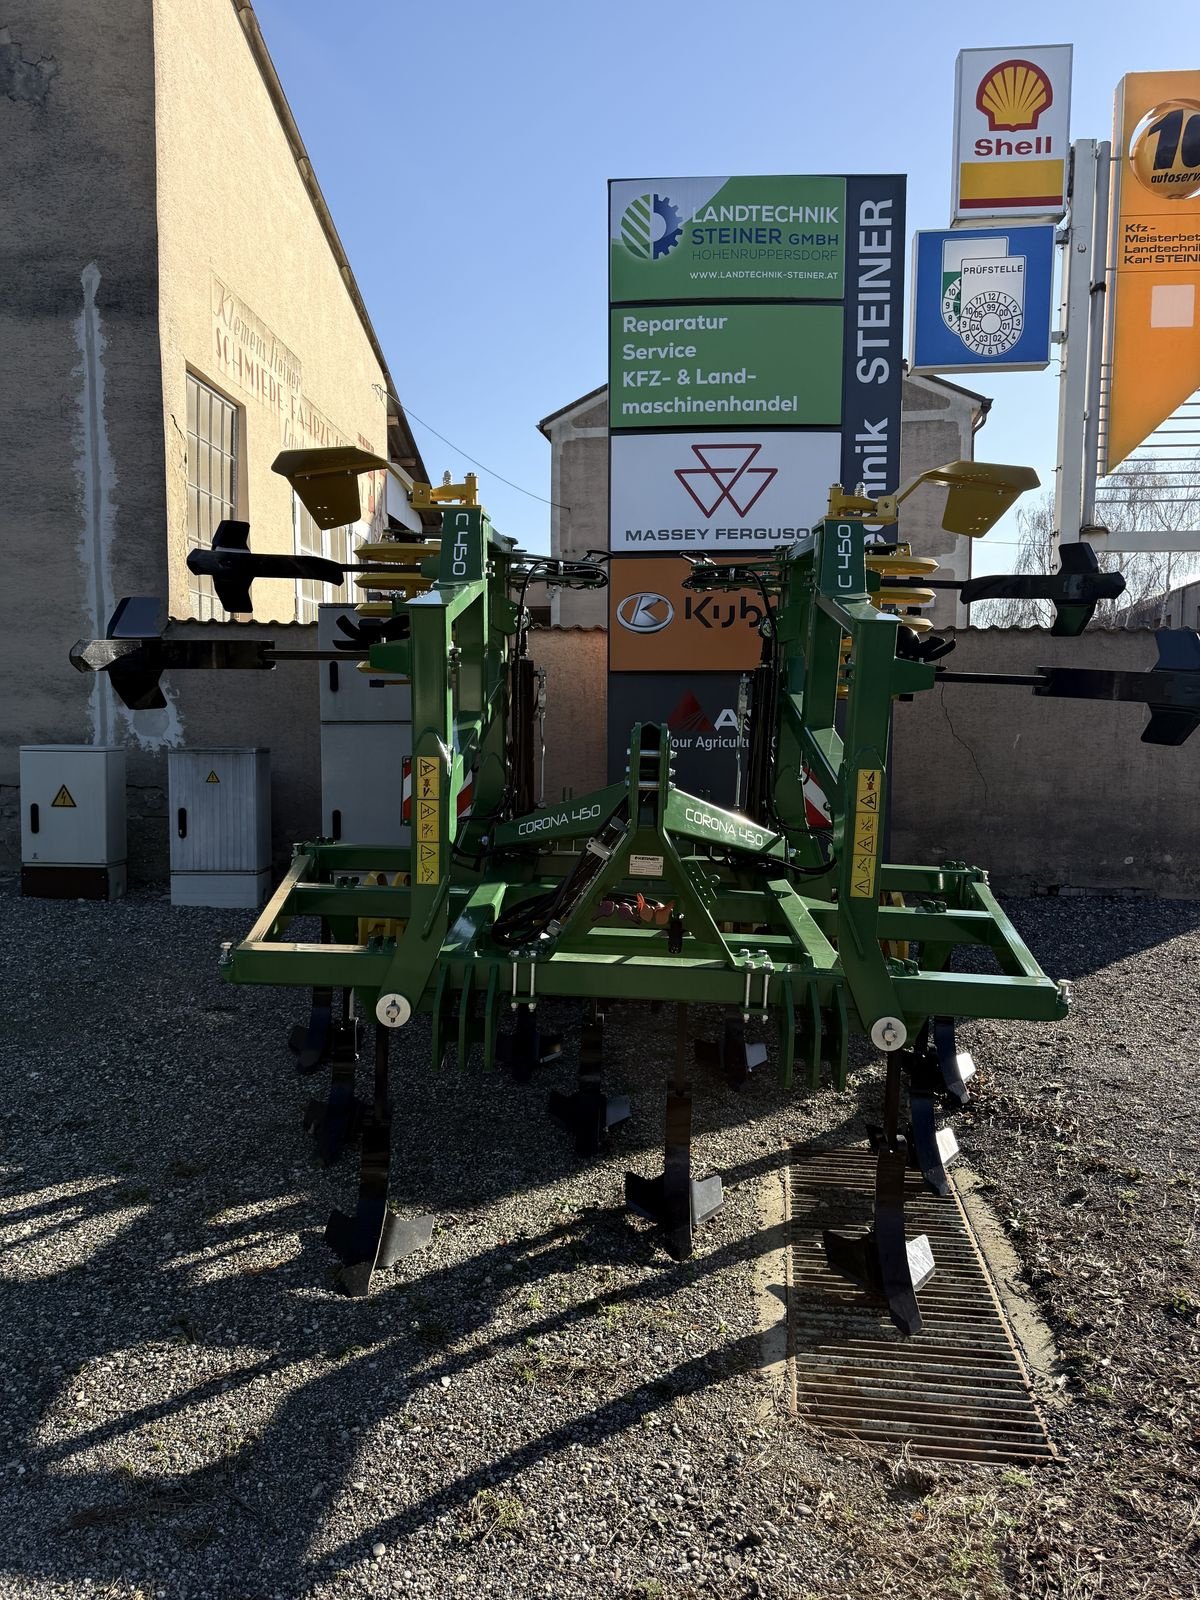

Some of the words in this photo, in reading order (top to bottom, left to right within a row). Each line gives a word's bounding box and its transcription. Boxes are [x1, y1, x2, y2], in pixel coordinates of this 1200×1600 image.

[974, 136, 1052, 156] Shell
[692, 205, 839, 223] LANDTECHNIK
[692, 227, 782, 245] STEINER
[788, 233, 839, 245] GMBH
[692, 248, 838, 261] HOHENRUPPERSDORF
[1124, 244, 1200, 253] Landtechni
[1124, 255, 1152, 264] Karl
[1155, 254, 1200, 263] STEIN
[689, 271, 839, 280] WWW.LANDTECHNIK-STEINER.AT
[963, 264, 1024, 275] PRÜFSTELLE
[856, 199, 893, 384] STEINER
[623, 315, 728, 336] Reparatur
[622, 342, 697, 360] Service
[623, 370, 671, 388] KFZ-
[677, 368, 691, 385] &
[696, 367, 757, 385] Land-
[622, 395, 798, 415] maschinenhandel
[455, 513, 469, 526] C
[625, 529, 709, 541] MASSEY
[715, 527, 810, 541] FERGUSO
[452, 531, 469, 576] 450
[837, 524, 852, 569] 450
[837, 575, 852, 588] C
[685, 596, 770, 628] Kub
[670, 737, 693, 748] our
[518, 812, 569, 836] CORONA
[571, 804, 601, 821] 450
[685, 808, 736, 836] CORONA
[737, 827, 763, 846] 450
